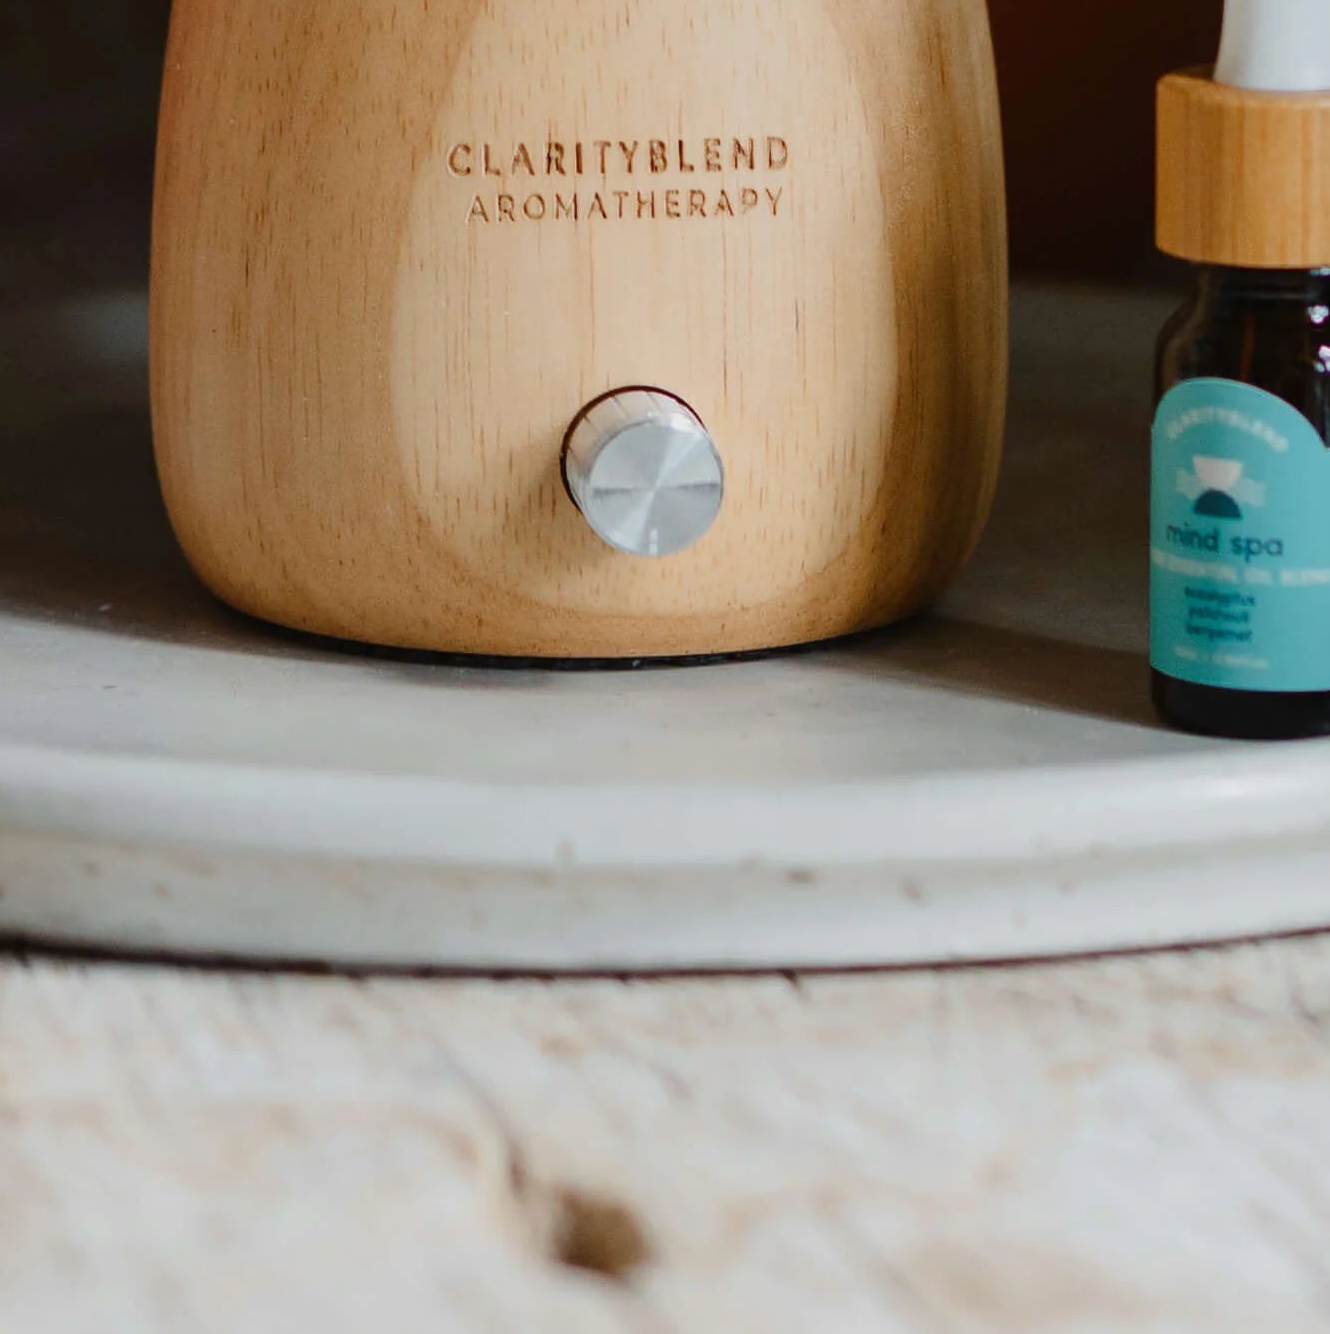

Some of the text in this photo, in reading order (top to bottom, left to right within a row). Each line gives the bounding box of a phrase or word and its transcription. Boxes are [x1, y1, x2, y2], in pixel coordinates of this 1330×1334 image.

[446, 136, 790, 177] CLARITYBLEND
[466, 186, 784, 223] AROMATHERAPY
[1166, 521, 1284, 563] mind spa
